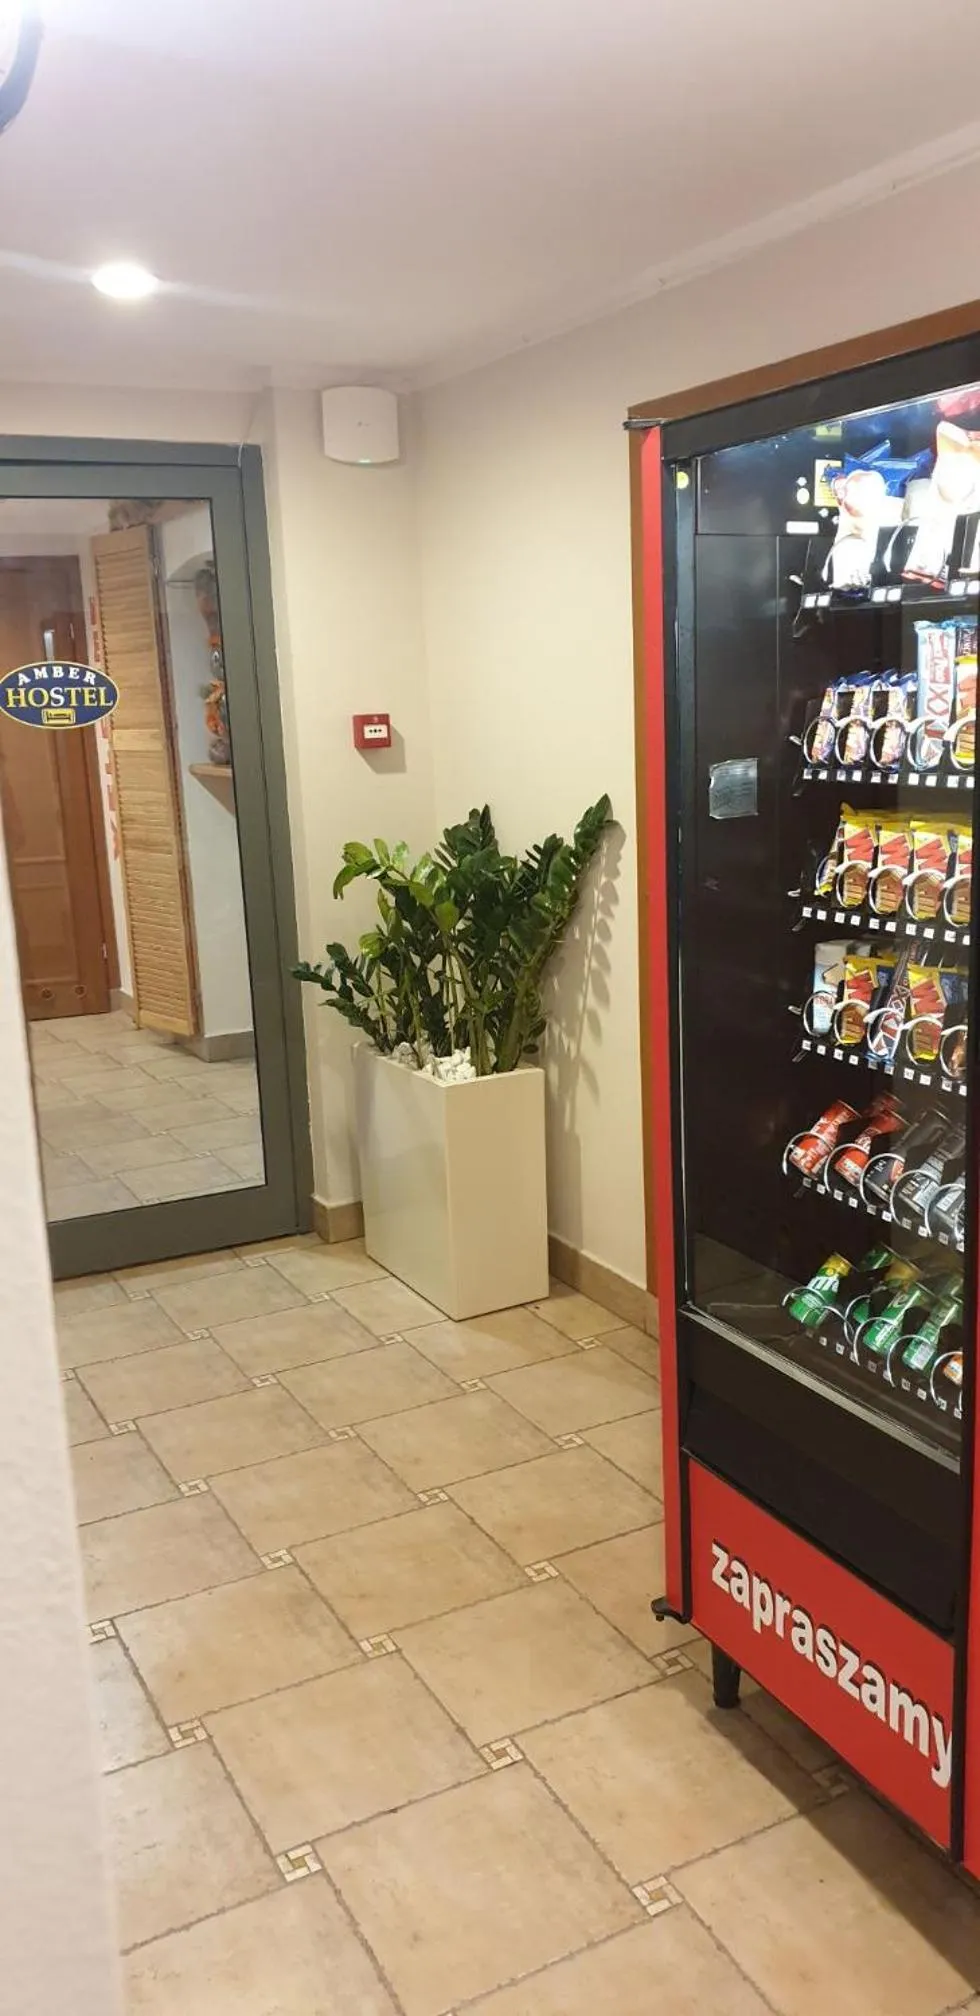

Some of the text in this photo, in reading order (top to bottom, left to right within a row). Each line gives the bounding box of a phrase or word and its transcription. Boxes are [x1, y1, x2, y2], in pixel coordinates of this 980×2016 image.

[18, 665, 97, 687] AMBER
[5, 686, 114, 708] HOSTEL
[711, 1539, 953, 1789] zapraszamy
